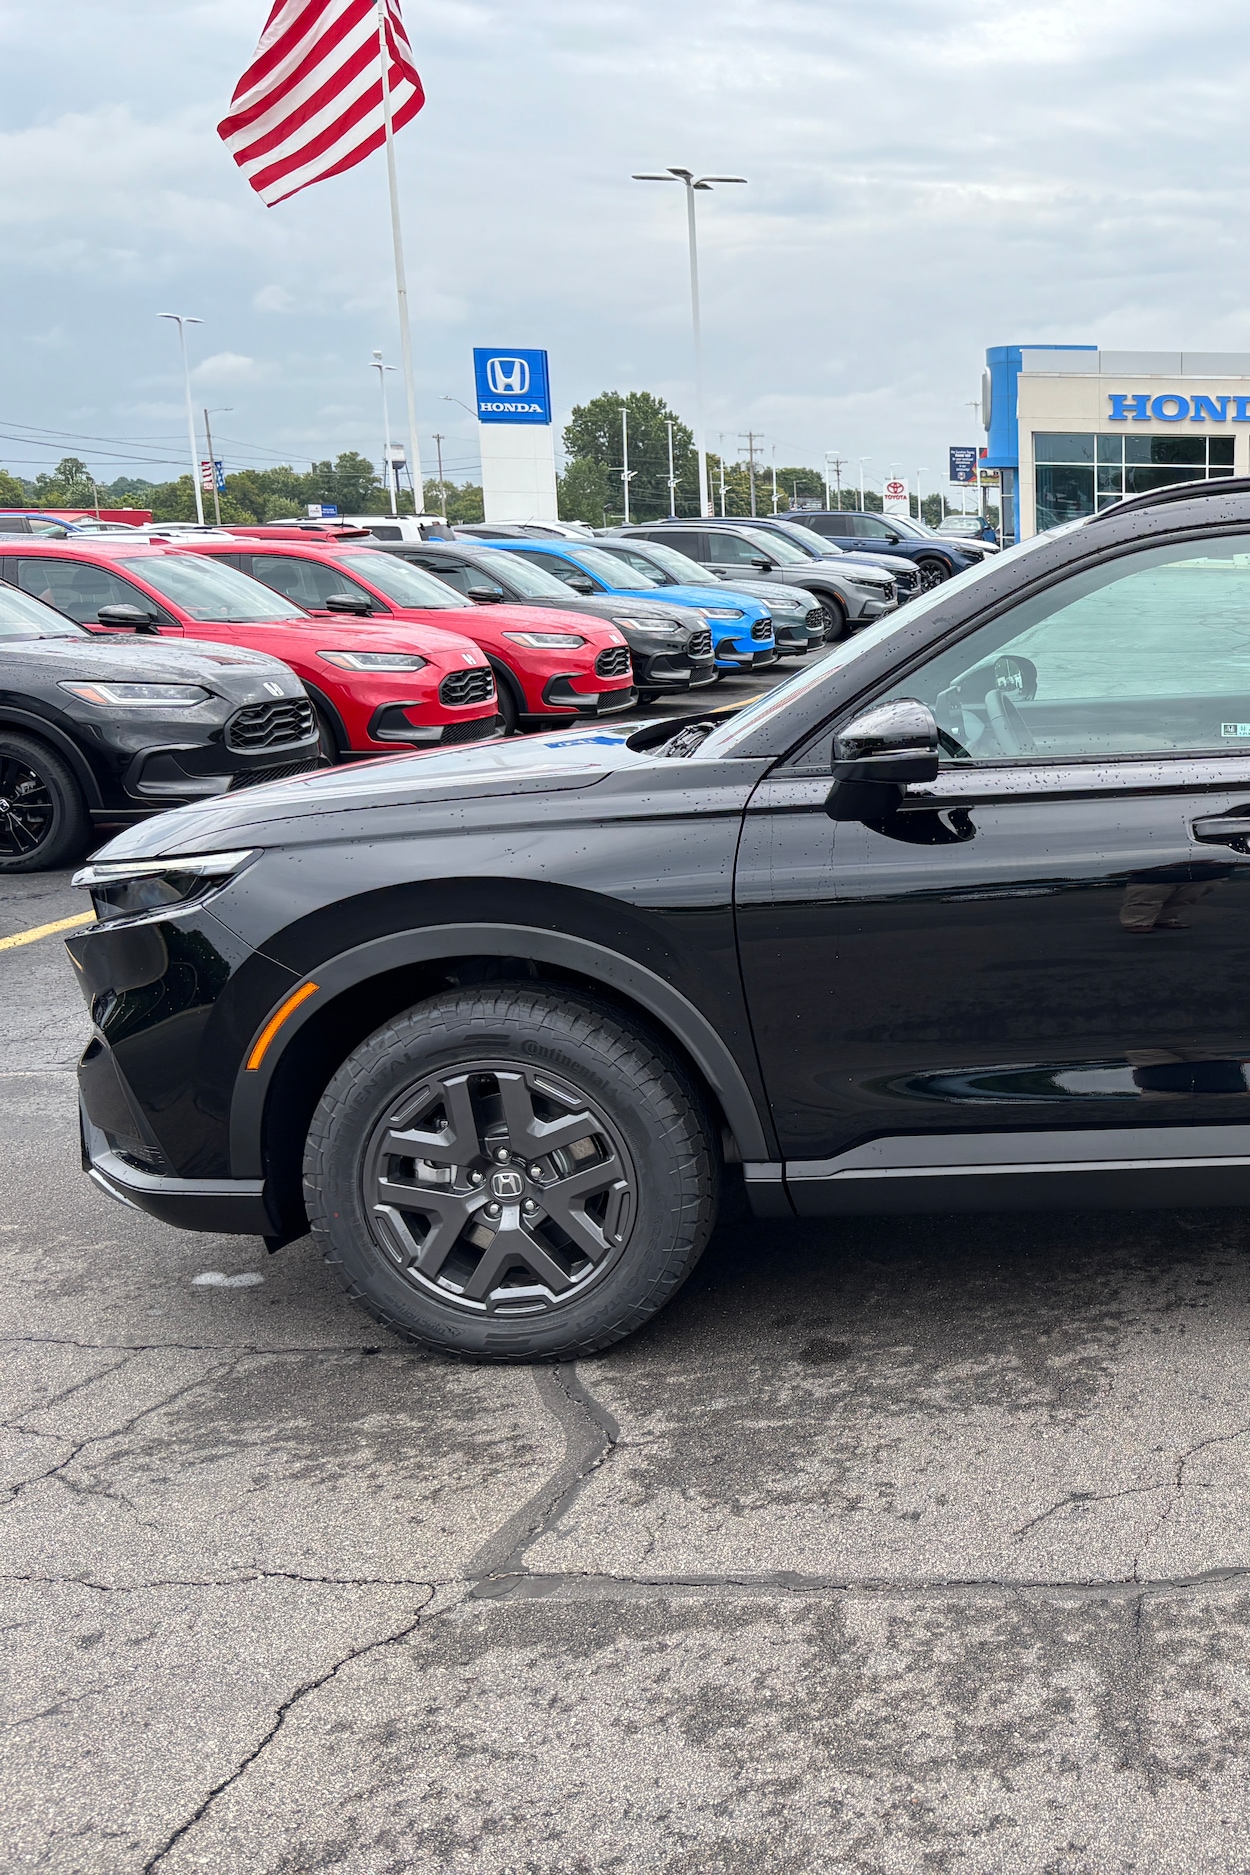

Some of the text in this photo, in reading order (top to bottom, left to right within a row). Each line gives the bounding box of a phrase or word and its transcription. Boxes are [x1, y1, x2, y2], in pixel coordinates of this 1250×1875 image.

[480, 403, 544, 413] HONDA
[520, 1038, 612, 1093] Continental
[327, 1050, 418, 1199] CONTINENTAL
